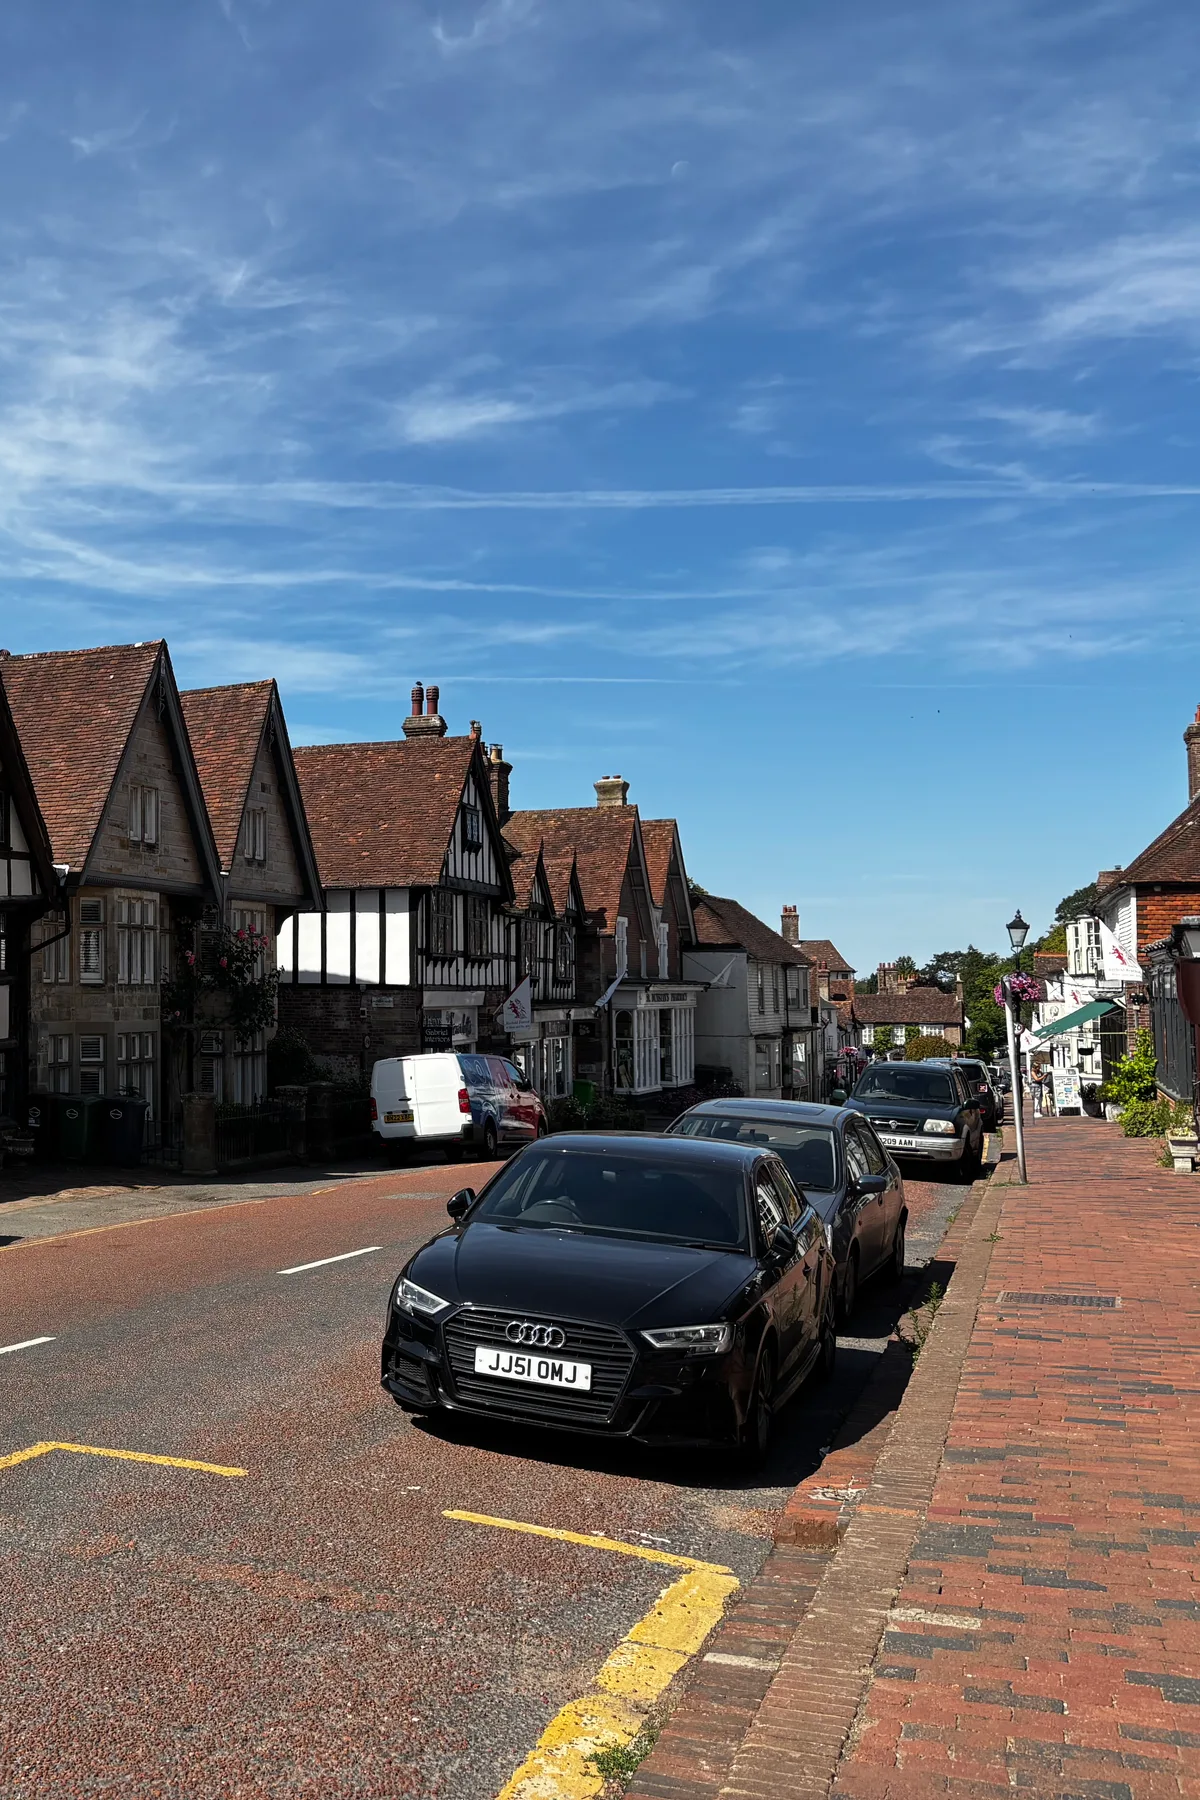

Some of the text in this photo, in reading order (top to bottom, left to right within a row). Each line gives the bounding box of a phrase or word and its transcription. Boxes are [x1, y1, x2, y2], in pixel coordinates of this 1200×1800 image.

[880, 1137, 897, 1145] 209
[488, 1353, 577, 1384] JJ51 OMJ
